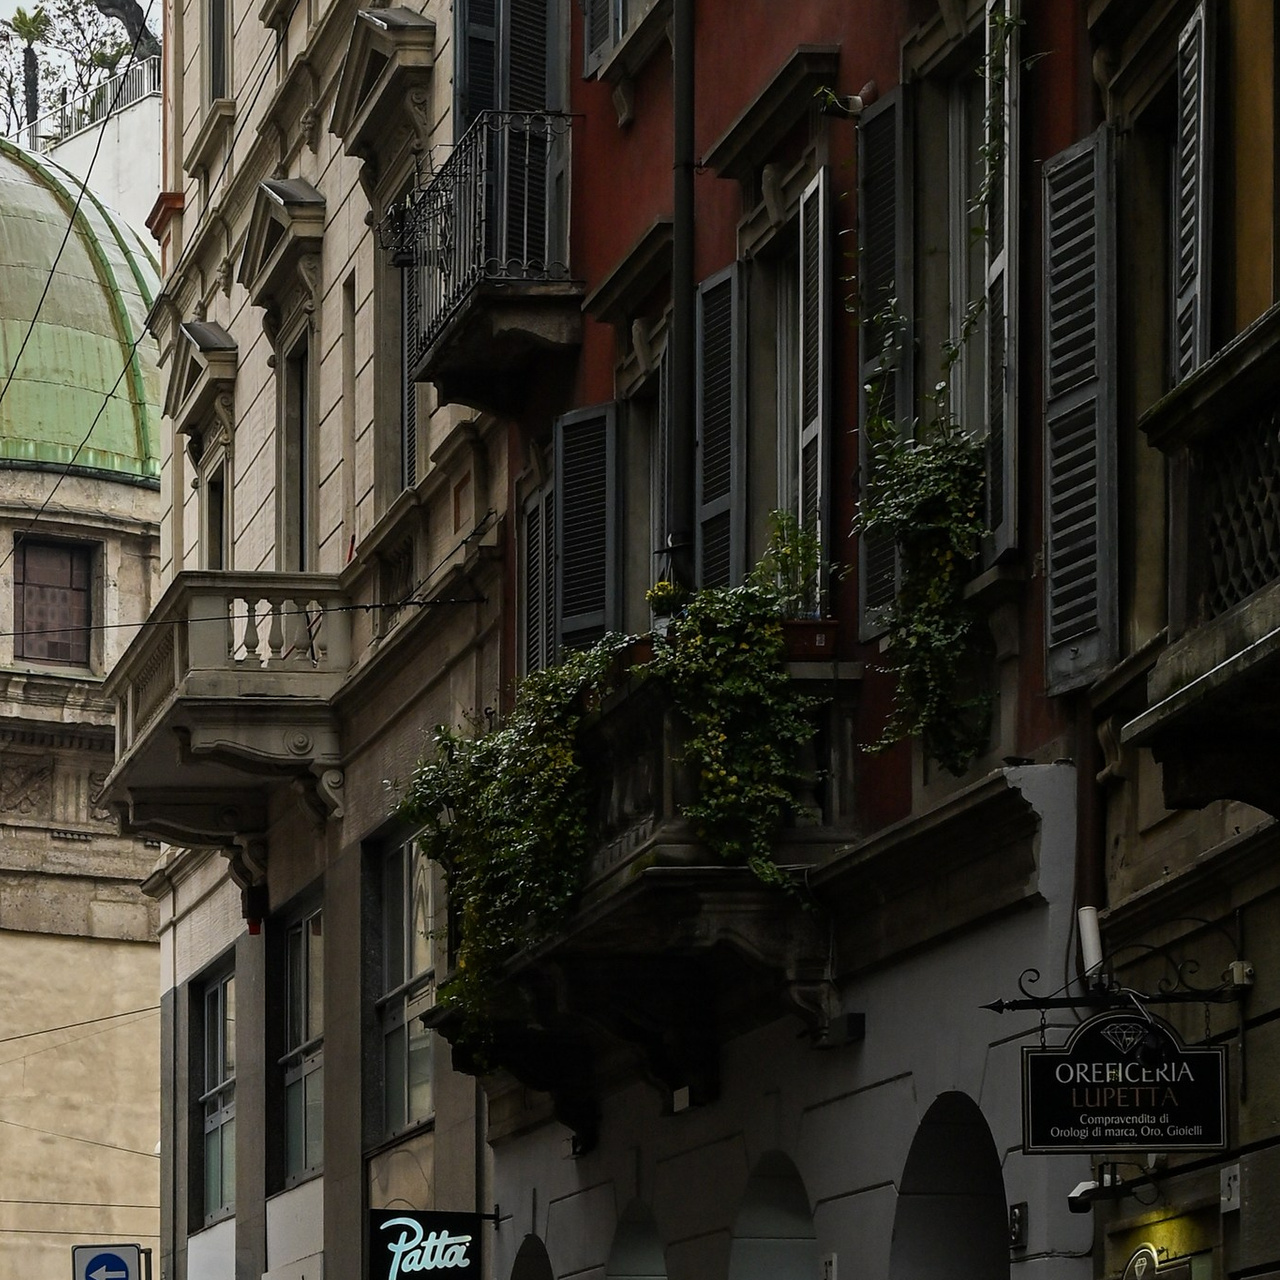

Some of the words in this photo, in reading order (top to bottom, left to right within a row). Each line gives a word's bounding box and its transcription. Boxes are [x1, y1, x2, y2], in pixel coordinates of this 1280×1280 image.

[1054, 1062, 1196, 1084] OREFICERIA
[1071, 1087, 1180, 1108] LUPETTA
[1079, 1113, 1156, 1127] Compravendita
[1159, 1113, 1169, 1124] di
[1050, 1126, 1089, 1140] Orologi
[1091, 1126, 1102, 1137] di
[1104, 1128, 1138, 1138] marca,
[1166, 1125, 1203, 1137] Gioielli
